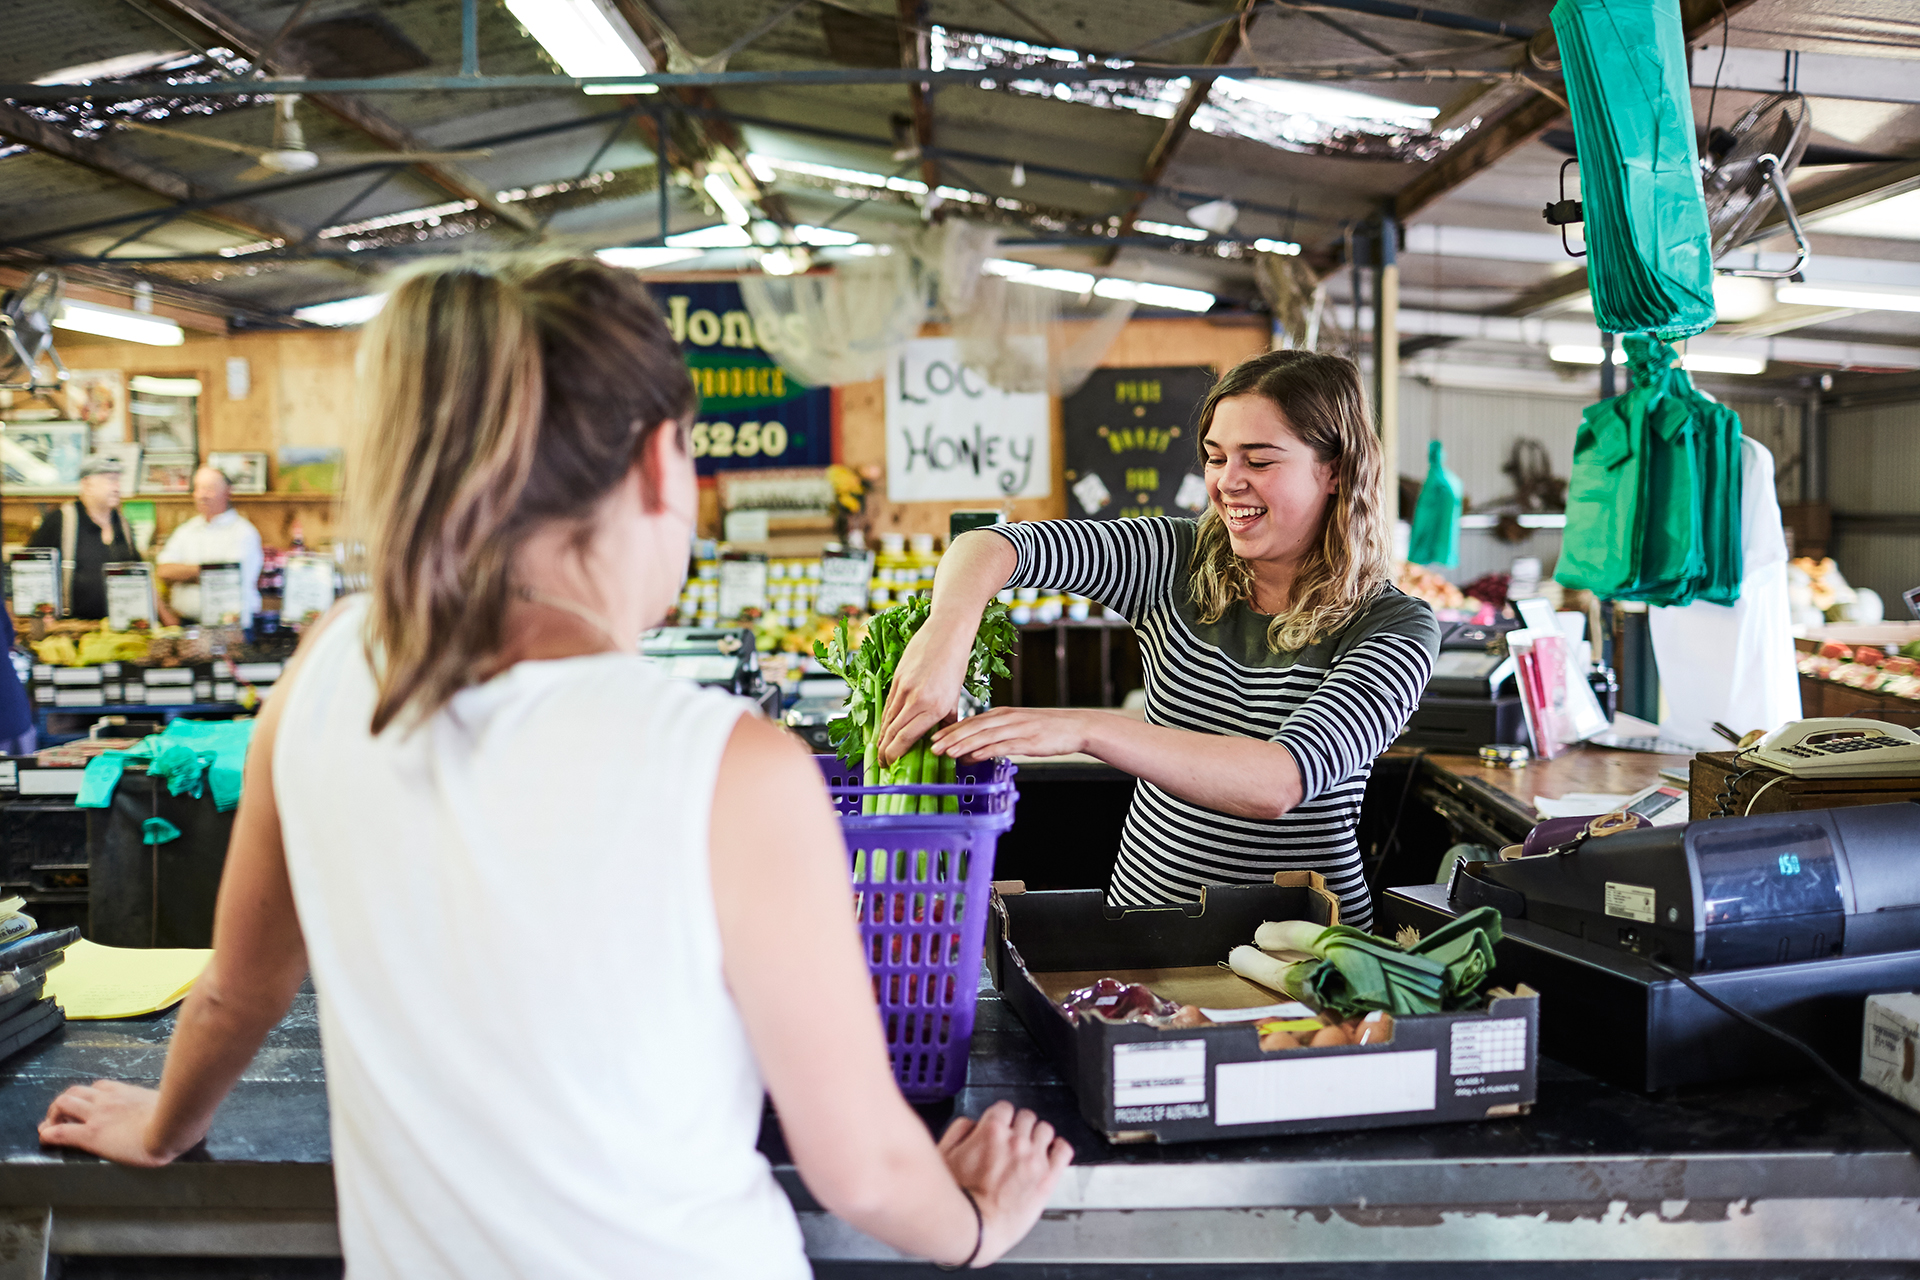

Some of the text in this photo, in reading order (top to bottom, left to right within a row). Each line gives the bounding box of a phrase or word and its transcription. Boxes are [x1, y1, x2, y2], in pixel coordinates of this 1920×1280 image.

[663, 295, 810, 360] Jones
[6, 924, 24, 935] Book
[1114, 1102, 1209, 1123] PRODUCE OF AUSTRALIA
